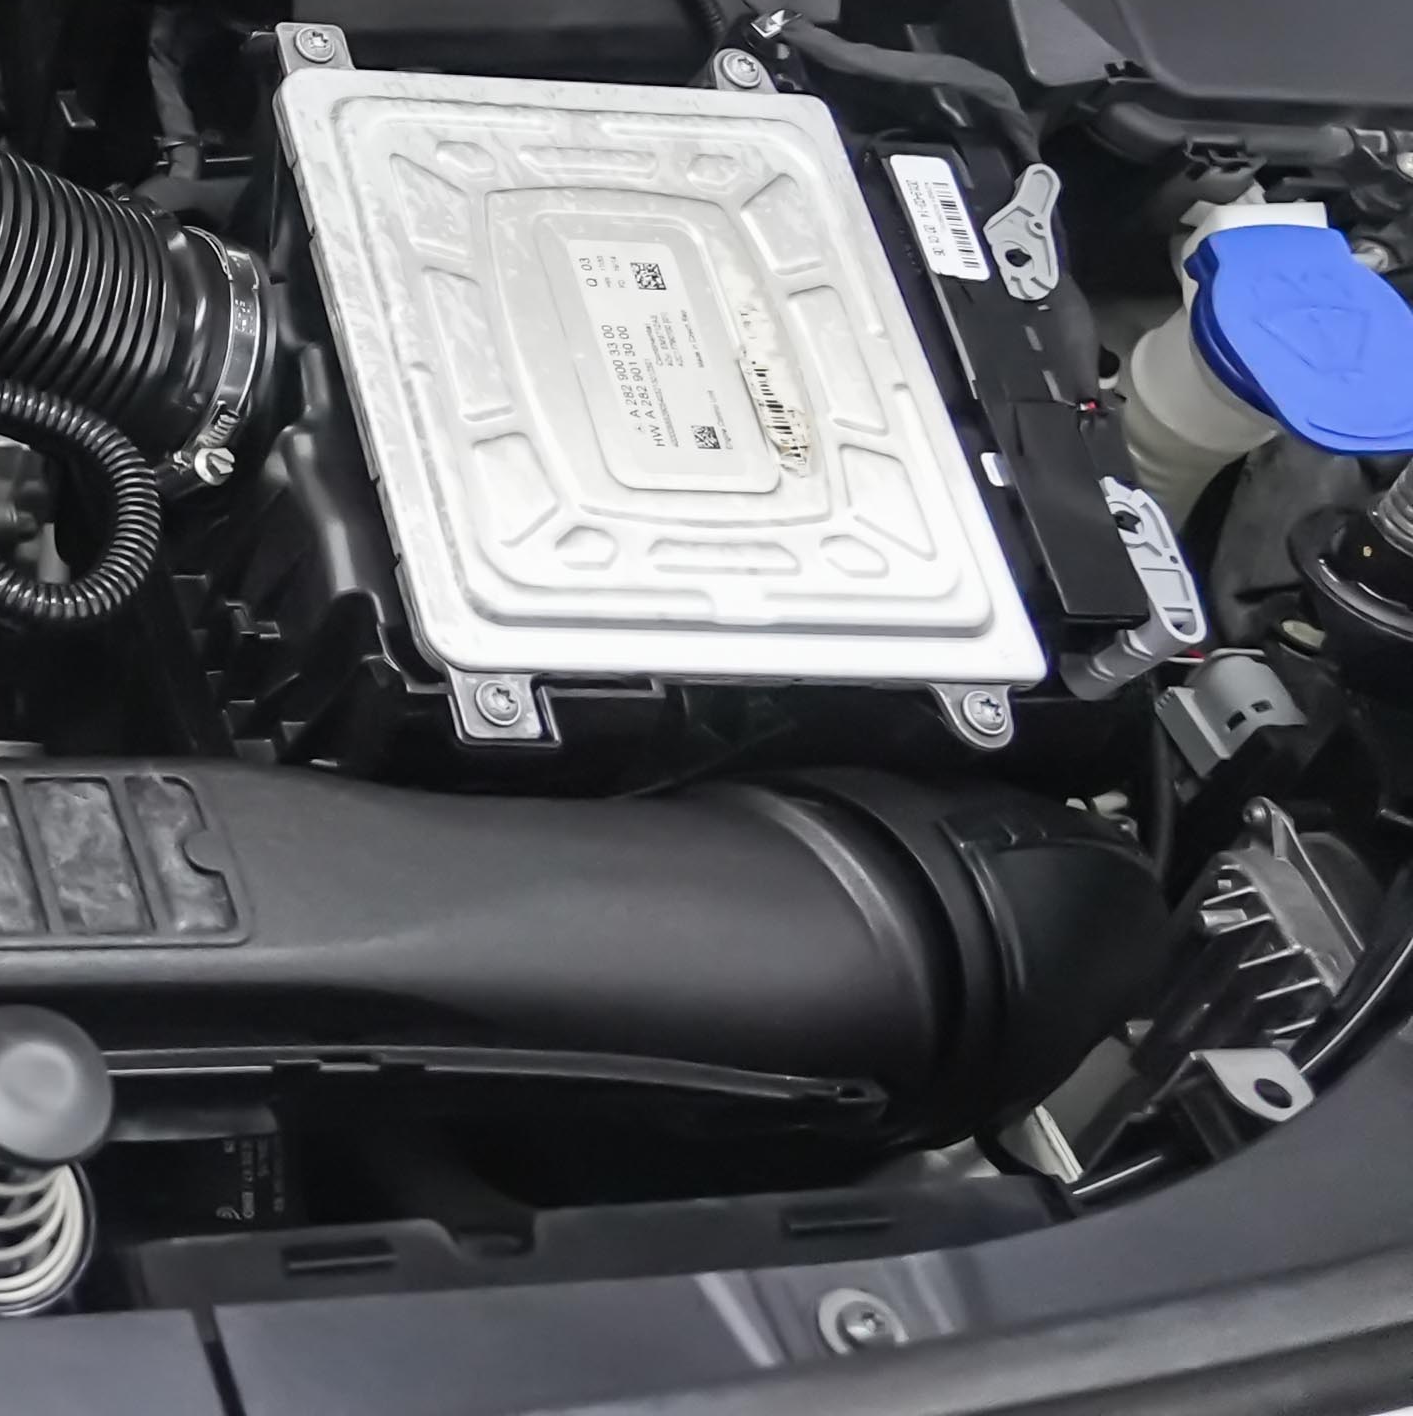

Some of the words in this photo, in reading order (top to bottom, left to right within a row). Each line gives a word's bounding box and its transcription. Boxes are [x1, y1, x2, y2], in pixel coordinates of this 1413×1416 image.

[579, 258, 592, 271] 03
[586, 278, 598, 287] Q
[601, 324, 615, 339] 00
[617, 326, 630, 340] 00
[610, 342, 621, 357] 33
[623, 343, 636, 357] 30
[613, 360, 629, 381] 900
[629, 362, 644, 382] 901
[621, 385, 638, 406] 282
[636, 386, 653, 407] 282
[630, 409, 641, 418] A
[645, 410, 656, 419] A
[648, 425, 666, 447] HW
